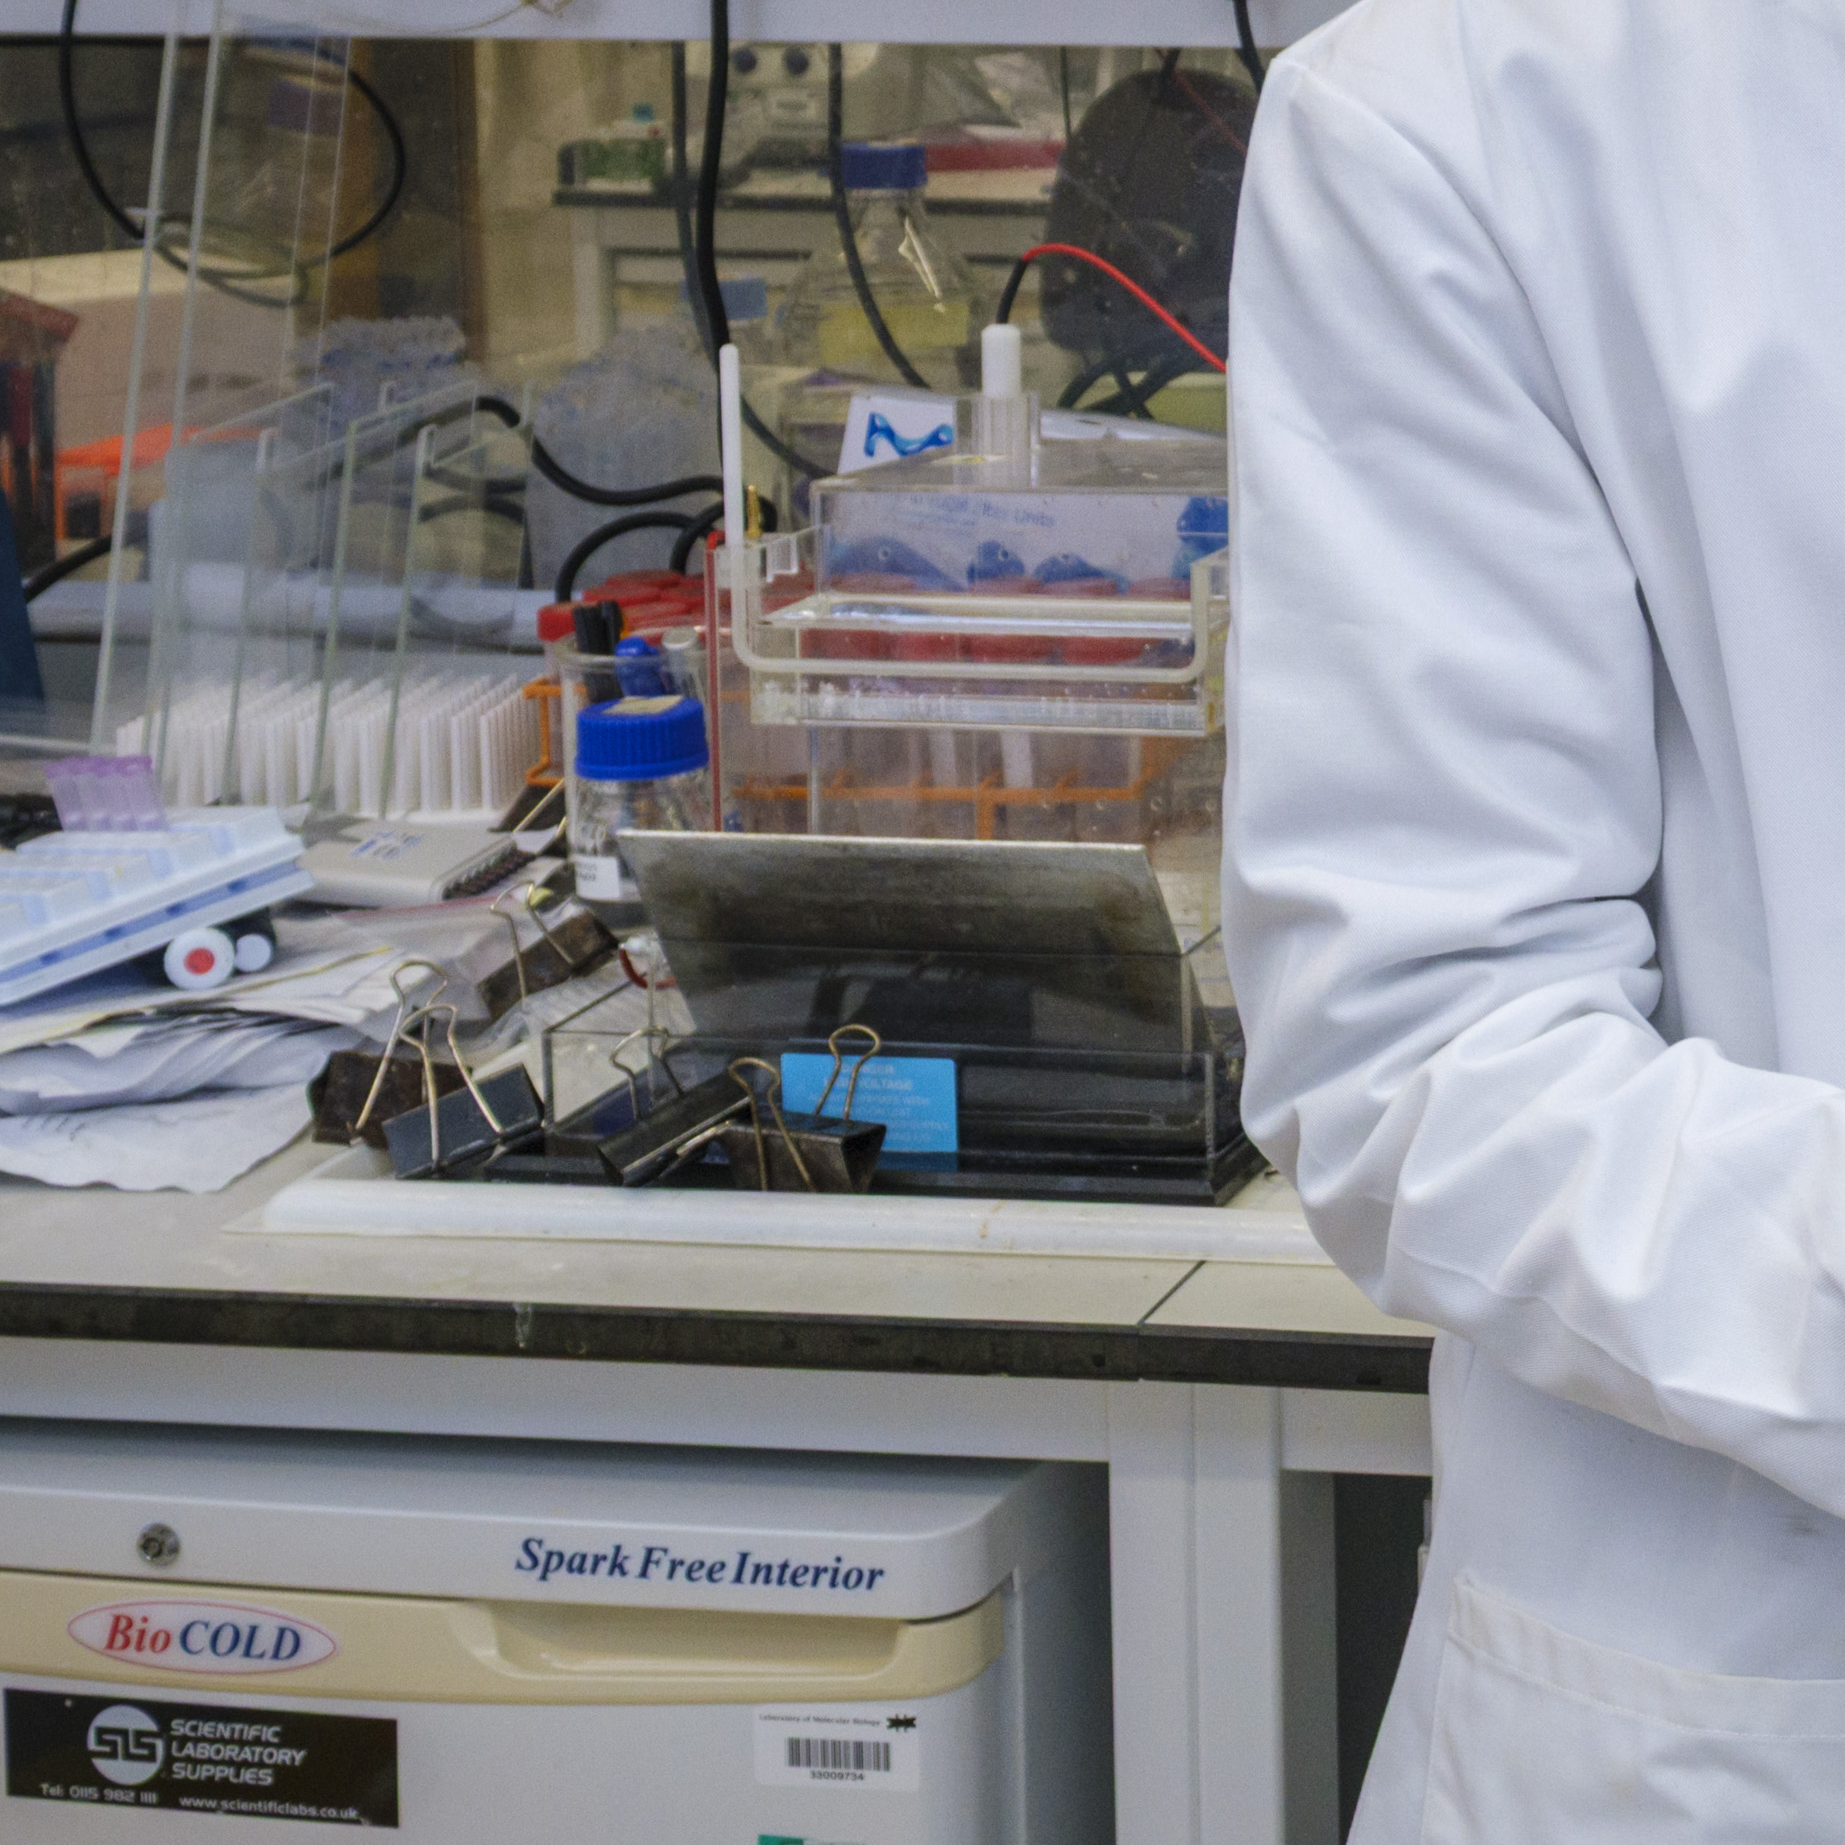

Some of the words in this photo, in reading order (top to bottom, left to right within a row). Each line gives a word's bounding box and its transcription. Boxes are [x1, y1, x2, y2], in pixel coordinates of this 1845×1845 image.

[514, 1536, 630, 1583] Spark
[635, 1545, 727, 1584] Free
[730, 1550, 885, 1591] Interior
[170, 1719, 282, 1744] SCIENTIFIC
[759, 1714, 800, 1723] Laboratory
[812, 1716, 850, 1724] Molecular
[853, 1718, 881, 1726] Biology
[171, 1740, 307, 1766] LABORATORY
[171, 1763, 273, 1786] SUPPLIES
[40, 1783, 64, 1797] Tel:
[69, 1786, 99, 1801] 0115
[103, 1788, 135, 1802] 982
[179, 1796, 358, 1820] www.scientificlabs.co.uk
